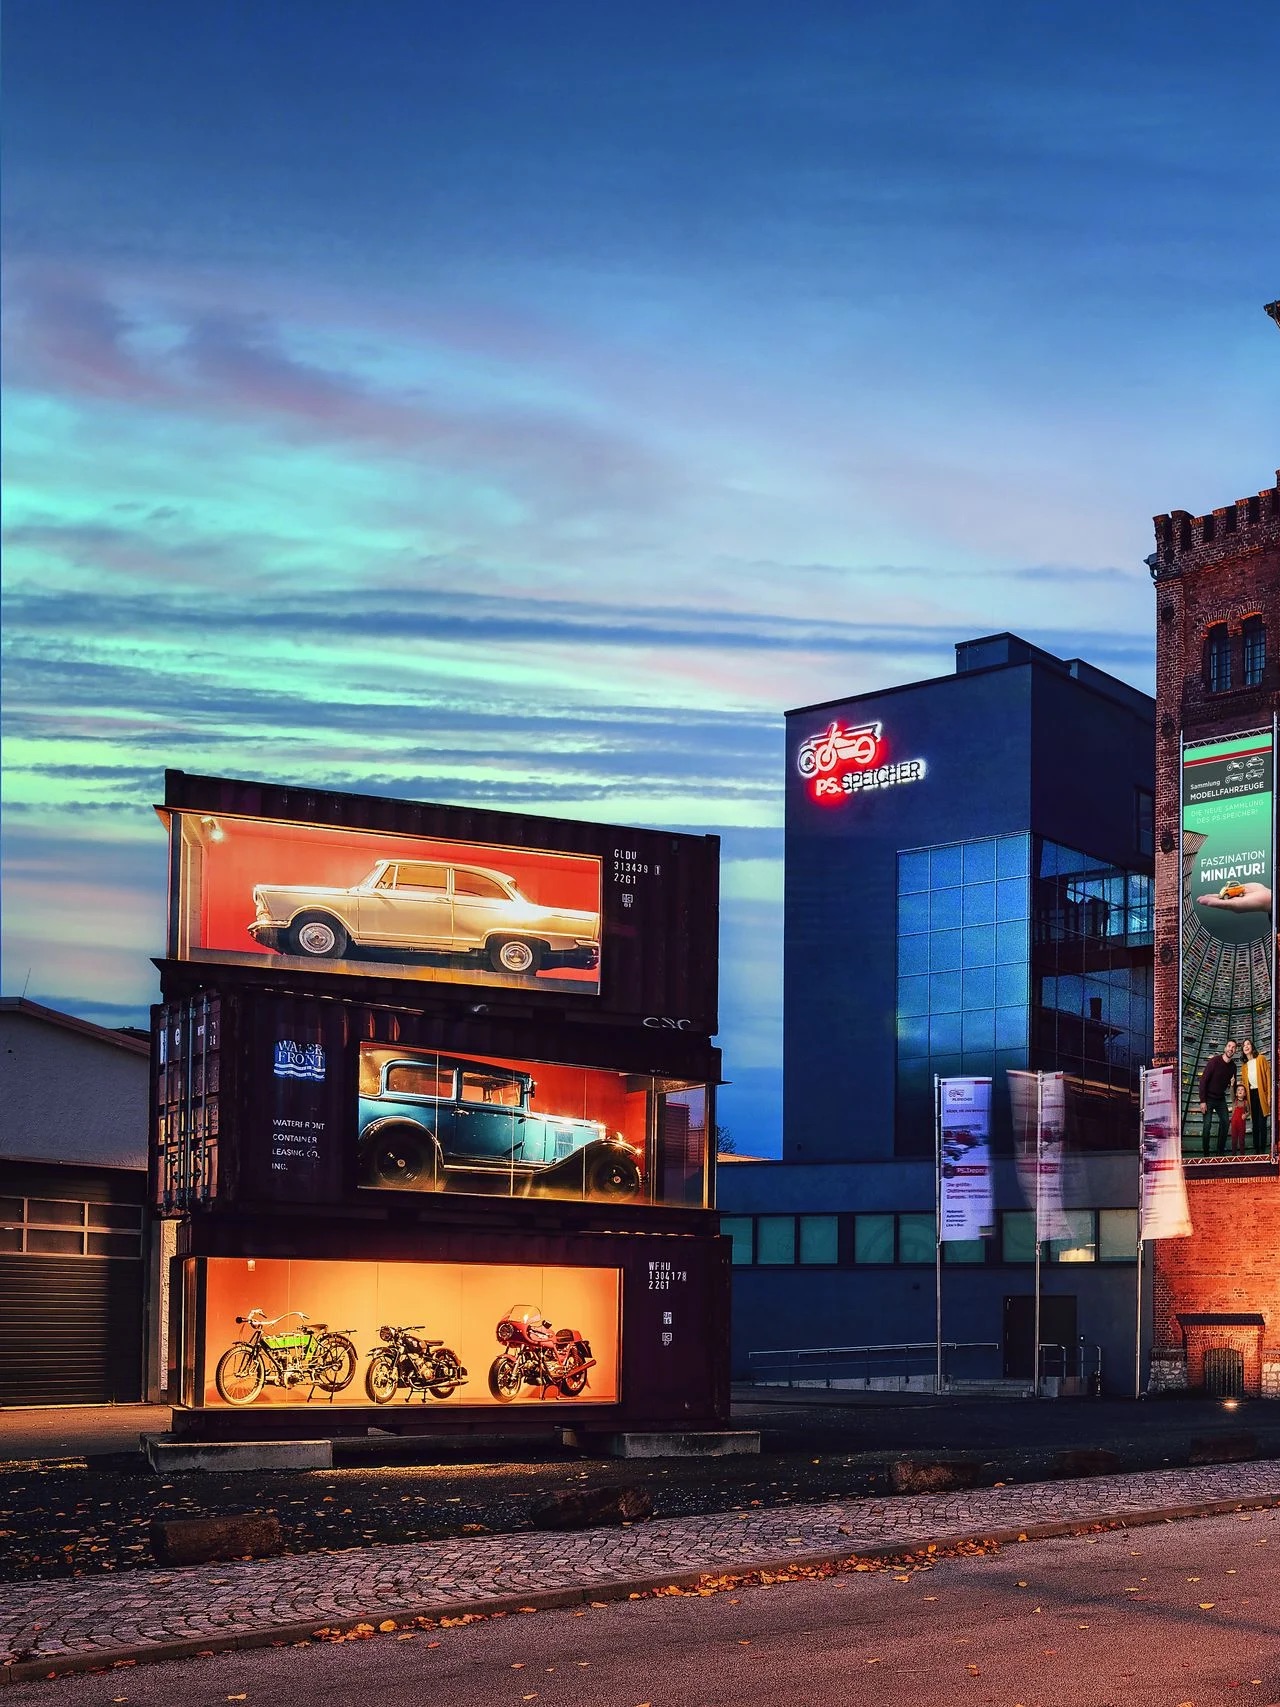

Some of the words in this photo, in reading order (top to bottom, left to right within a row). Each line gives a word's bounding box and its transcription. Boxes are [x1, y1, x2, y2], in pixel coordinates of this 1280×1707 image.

[1190, 780, 1220, 790] Sammlung
[1190, 781, 1264, 800] MODELLFAHRZEUGE
[1191, 809, 1202, 817] DIE
[1205, 807, 1222, 815] NEUE
[1225, 799, 1264, 811] SAMMLUNG
[1197, 816, 1209, 824] DES
[614, 849, 637, 859] GLDU
[1201, 850, 1265, 867] FASZINATION
[614, 861, 648, 873] 313439
[1201, 862, 1265, 882] MINIATUR!
[614, 873, 636, 884] 22G1
[278, 1051, 323, 1067] FRONT
[273, 1134, 317, 1143] CONTAINER
[648, 1262, 671, 1271] WFHU
[648, 1281, 669, 1290] 22G1
